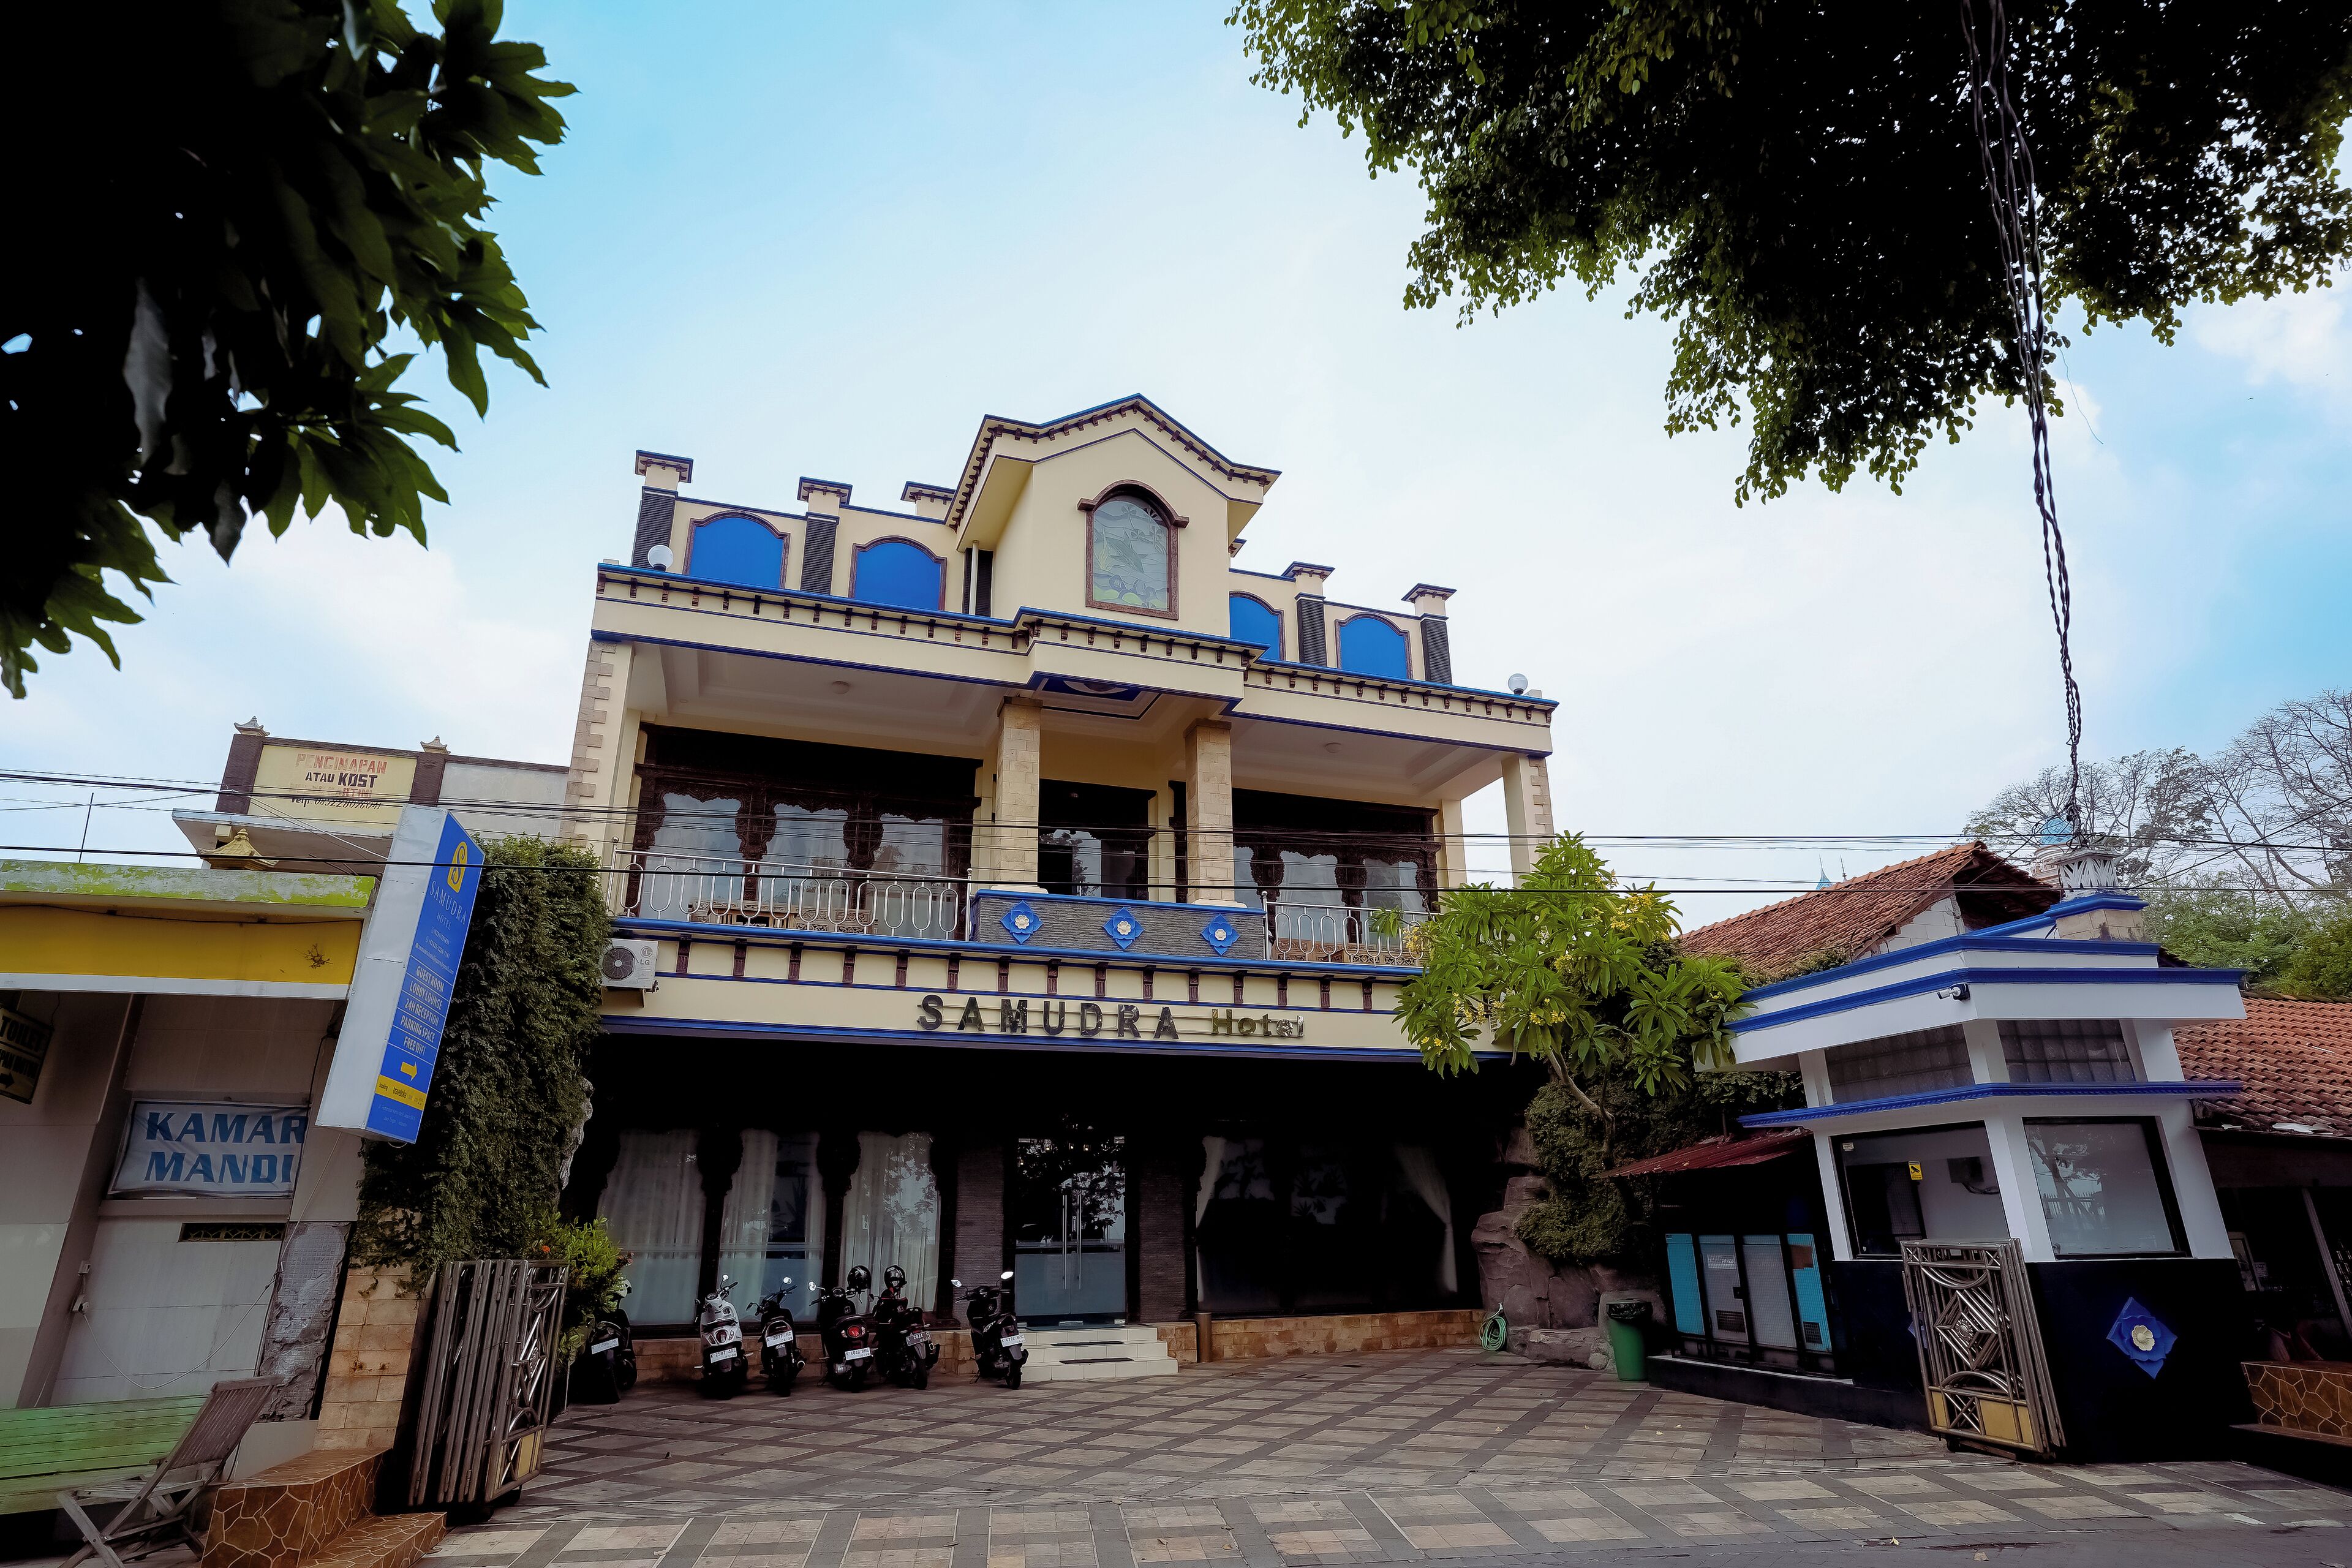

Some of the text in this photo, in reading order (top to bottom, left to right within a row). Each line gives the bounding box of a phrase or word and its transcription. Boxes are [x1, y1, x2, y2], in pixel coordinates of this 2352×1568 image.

[305, 772, 378, 788] ATAU KOST
[429, 880, 467, 925] SAMUDRA
[436, 911, 451, 930] HOTEL
[416, 965, 445, 993] GUEST ROOM
[409, 981, 443, 1011] LOBBY LOUNGE
[404, 998, 440, 1027] 24H RECEPTION
[919, 993, 1305, 1039] SAMUDRA Hotel
[0, 1014, 47, 1052] TOILET
[401, 1015, 435, 1043] PARKING SPACE
[403, 1036, 426, 1057] FREE WIFI
[145, 1112, 309, 1144] KAMAR
[143, 1151, 295, 1183] MANDI
